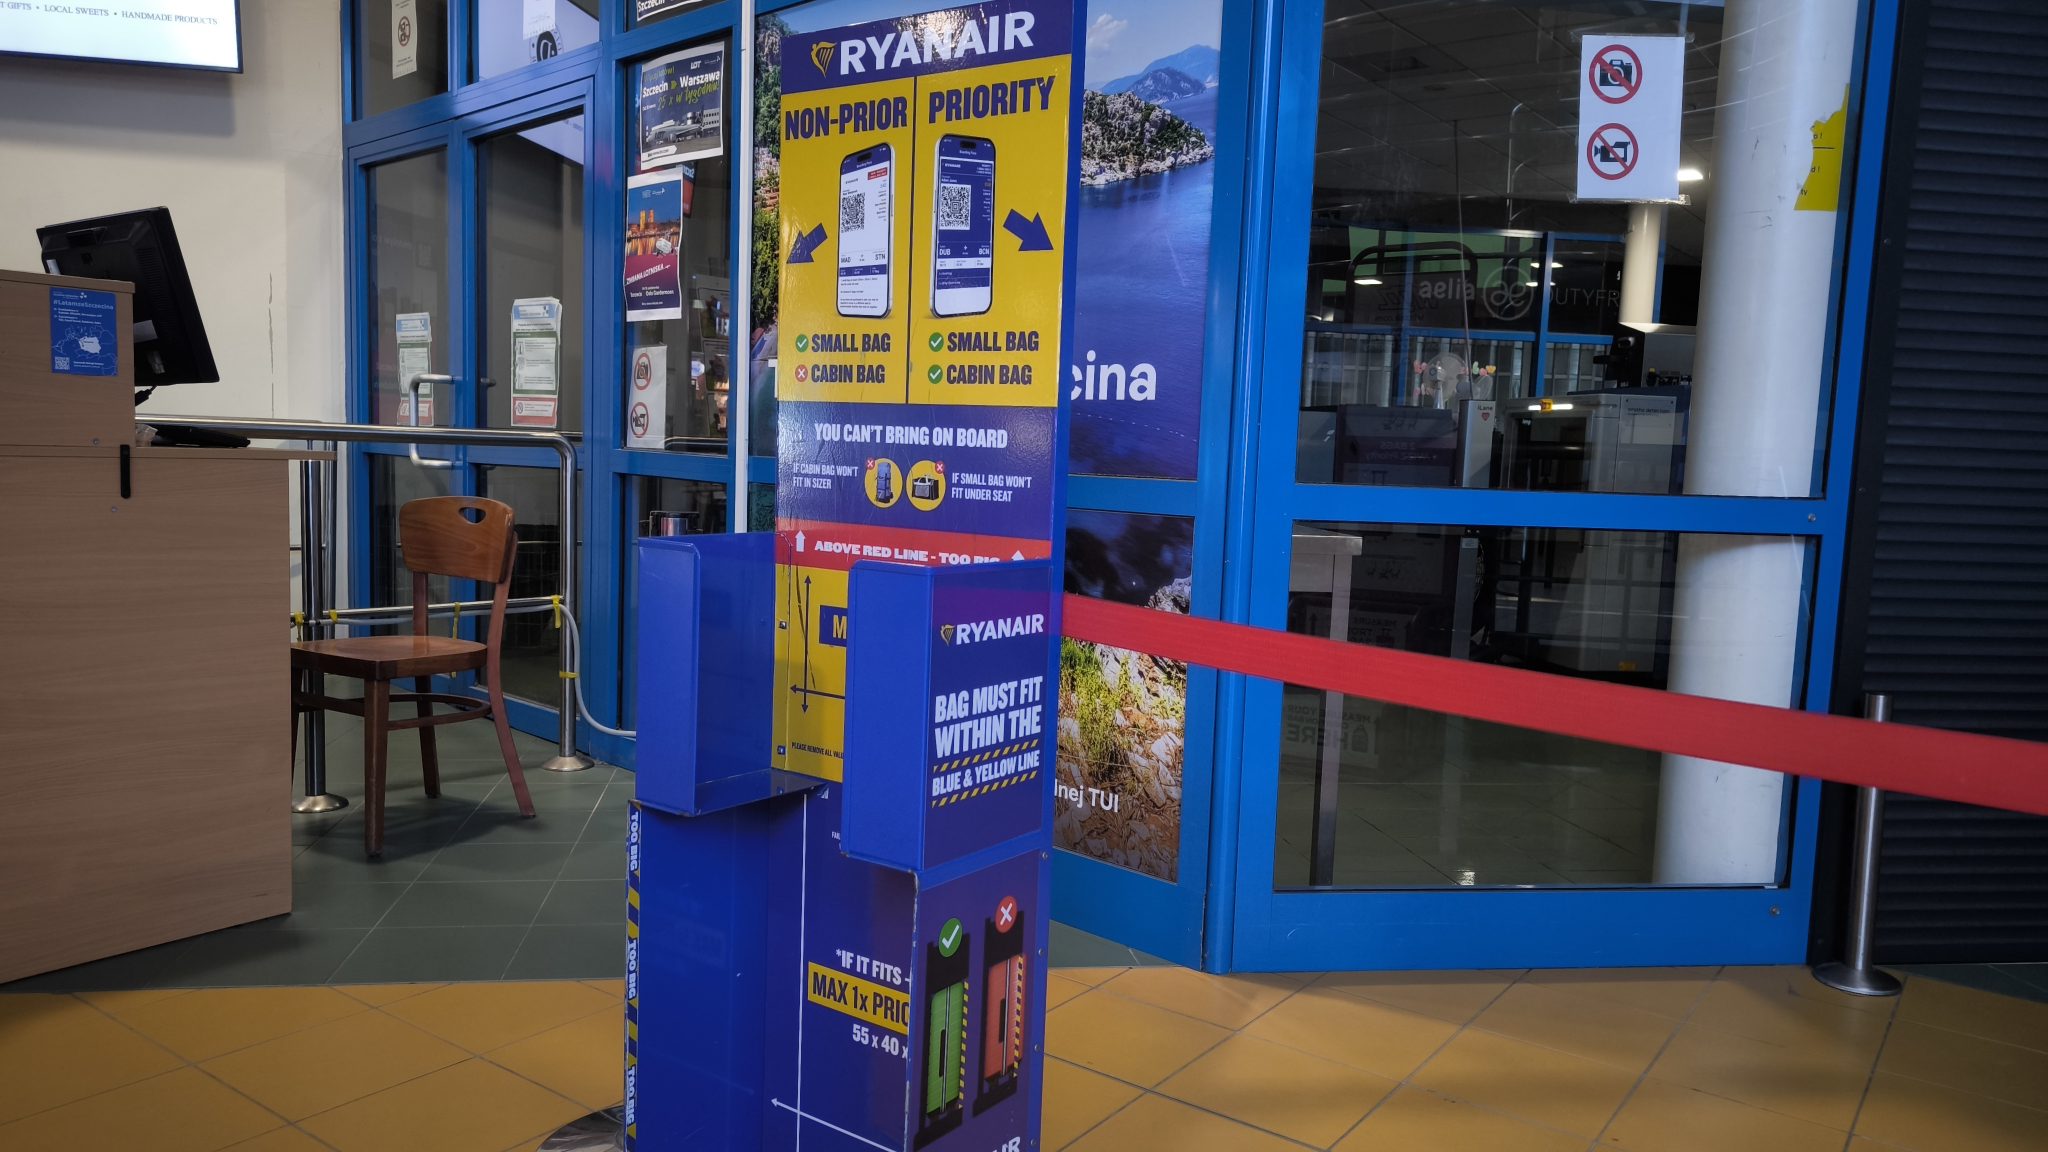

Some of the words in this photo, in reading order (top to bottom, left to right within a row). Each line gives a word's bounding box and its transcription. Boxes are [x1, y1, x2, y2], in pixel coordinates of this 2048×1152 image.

[7, 2, 32, 11] GIFTS
[44, 4, 74, 14] LOCAL
[75, 7, 110, 17] SWEETS
[121, 10, 173, 22] HANDMADE
[174, 15, 218, 25] PRODUCTS
[839, 10, 1035, 75] RYANAIR
[642, 82, 669, 98] Szczecin
[679, 70, 720, 88] Warszawa
[928, 75, 1056, 125] PRIORITY
[785, 96, 908, 141] NON-PRIOR
[939, 248, 951, 256] DUB
[1418, 280, 1476, 300] aelia
[811, 333, 858, 353] SMALL
[861, 333, 891, 353] BAG
[947, 331, 1002, 352] SMALL
[1005, 330, 1039, 352] BAG
[811, 364, 853, 383] CABIN
[856, 364, 885, 384] BAG
[946, 364, 995, 385] CABIN
[998, 364, 1032, 385] BAG
[814, 423, 841, 442] YOU
[843, 425, 883, 444] CAN'T
[885, 426, 929, 446] BRING
[932, 427, 954, 446] ON
[956, 428, 1008, 448] BOARD
[793, 463, 800, 473] IF
[800, 463, 820, 475] CABIN
[821, 464, 835, 476] BAG
[836, 465, 858, 477] WON'T
[793, 476, 803, 488] FIT
[804, 477, 811, 488] IN
[812, 477, 832, 489] SIZER
[952, 472, 959, 483] IF
[960, 472, 987, 486] SMALL
[987, 474, 1004, 487] BAG
[1005, 475, 1032, 489] WON'T
[952, 487, 963, 499] FIT
[964, 488, 991, 501] UNDER
[992, 489, 1012, 502] SEAT
[814, 540, 861, 554] ABOVE
[863, 545, 892, 558] RED
[893, 548, 928, 562] LINE
[938, 552, 972, 565] TOO
[956, 613, 1045, 645] RYANAIR
[934, 690, 970, 724] BAG
[972, 680, 1018, 716] MUST
[1020, 676, 1043, 705] FIT
[934, 713, 1006, 759] WITHIN
[1008, 705, 1042, 740] THE
[791, 741, 807, 752] PLEASE
[824, 749, 833, 757] ALL
[932, 772, 962, 797] BLUE
[963, 768, 973, 788] &
[974, 755, 1017, 785] YELLOW
[1018, 750, 1040, 772] LINE
[1088, 787, 1119, 813] TUI
[630, 811, 639, 844] TOO
[630, 845, 639, 871] BIG
[628, 939, 637, 972] TOO
[856, 954, 870, 975] IT
[871, 960, 902, 986] FITS
[628, 972, 636, 999] BIG
[812, 971, 848, 1006] MAX
[852, 985, 869, 1013] 1x
[852, 1023, 870, 1045] 55
[871, 1034, 878, 1049] x
[881, 1034, 899, 1056] 40
[627, 1067, 636, 1098] TOO
[626, 1098, 635, 1126] BIG
